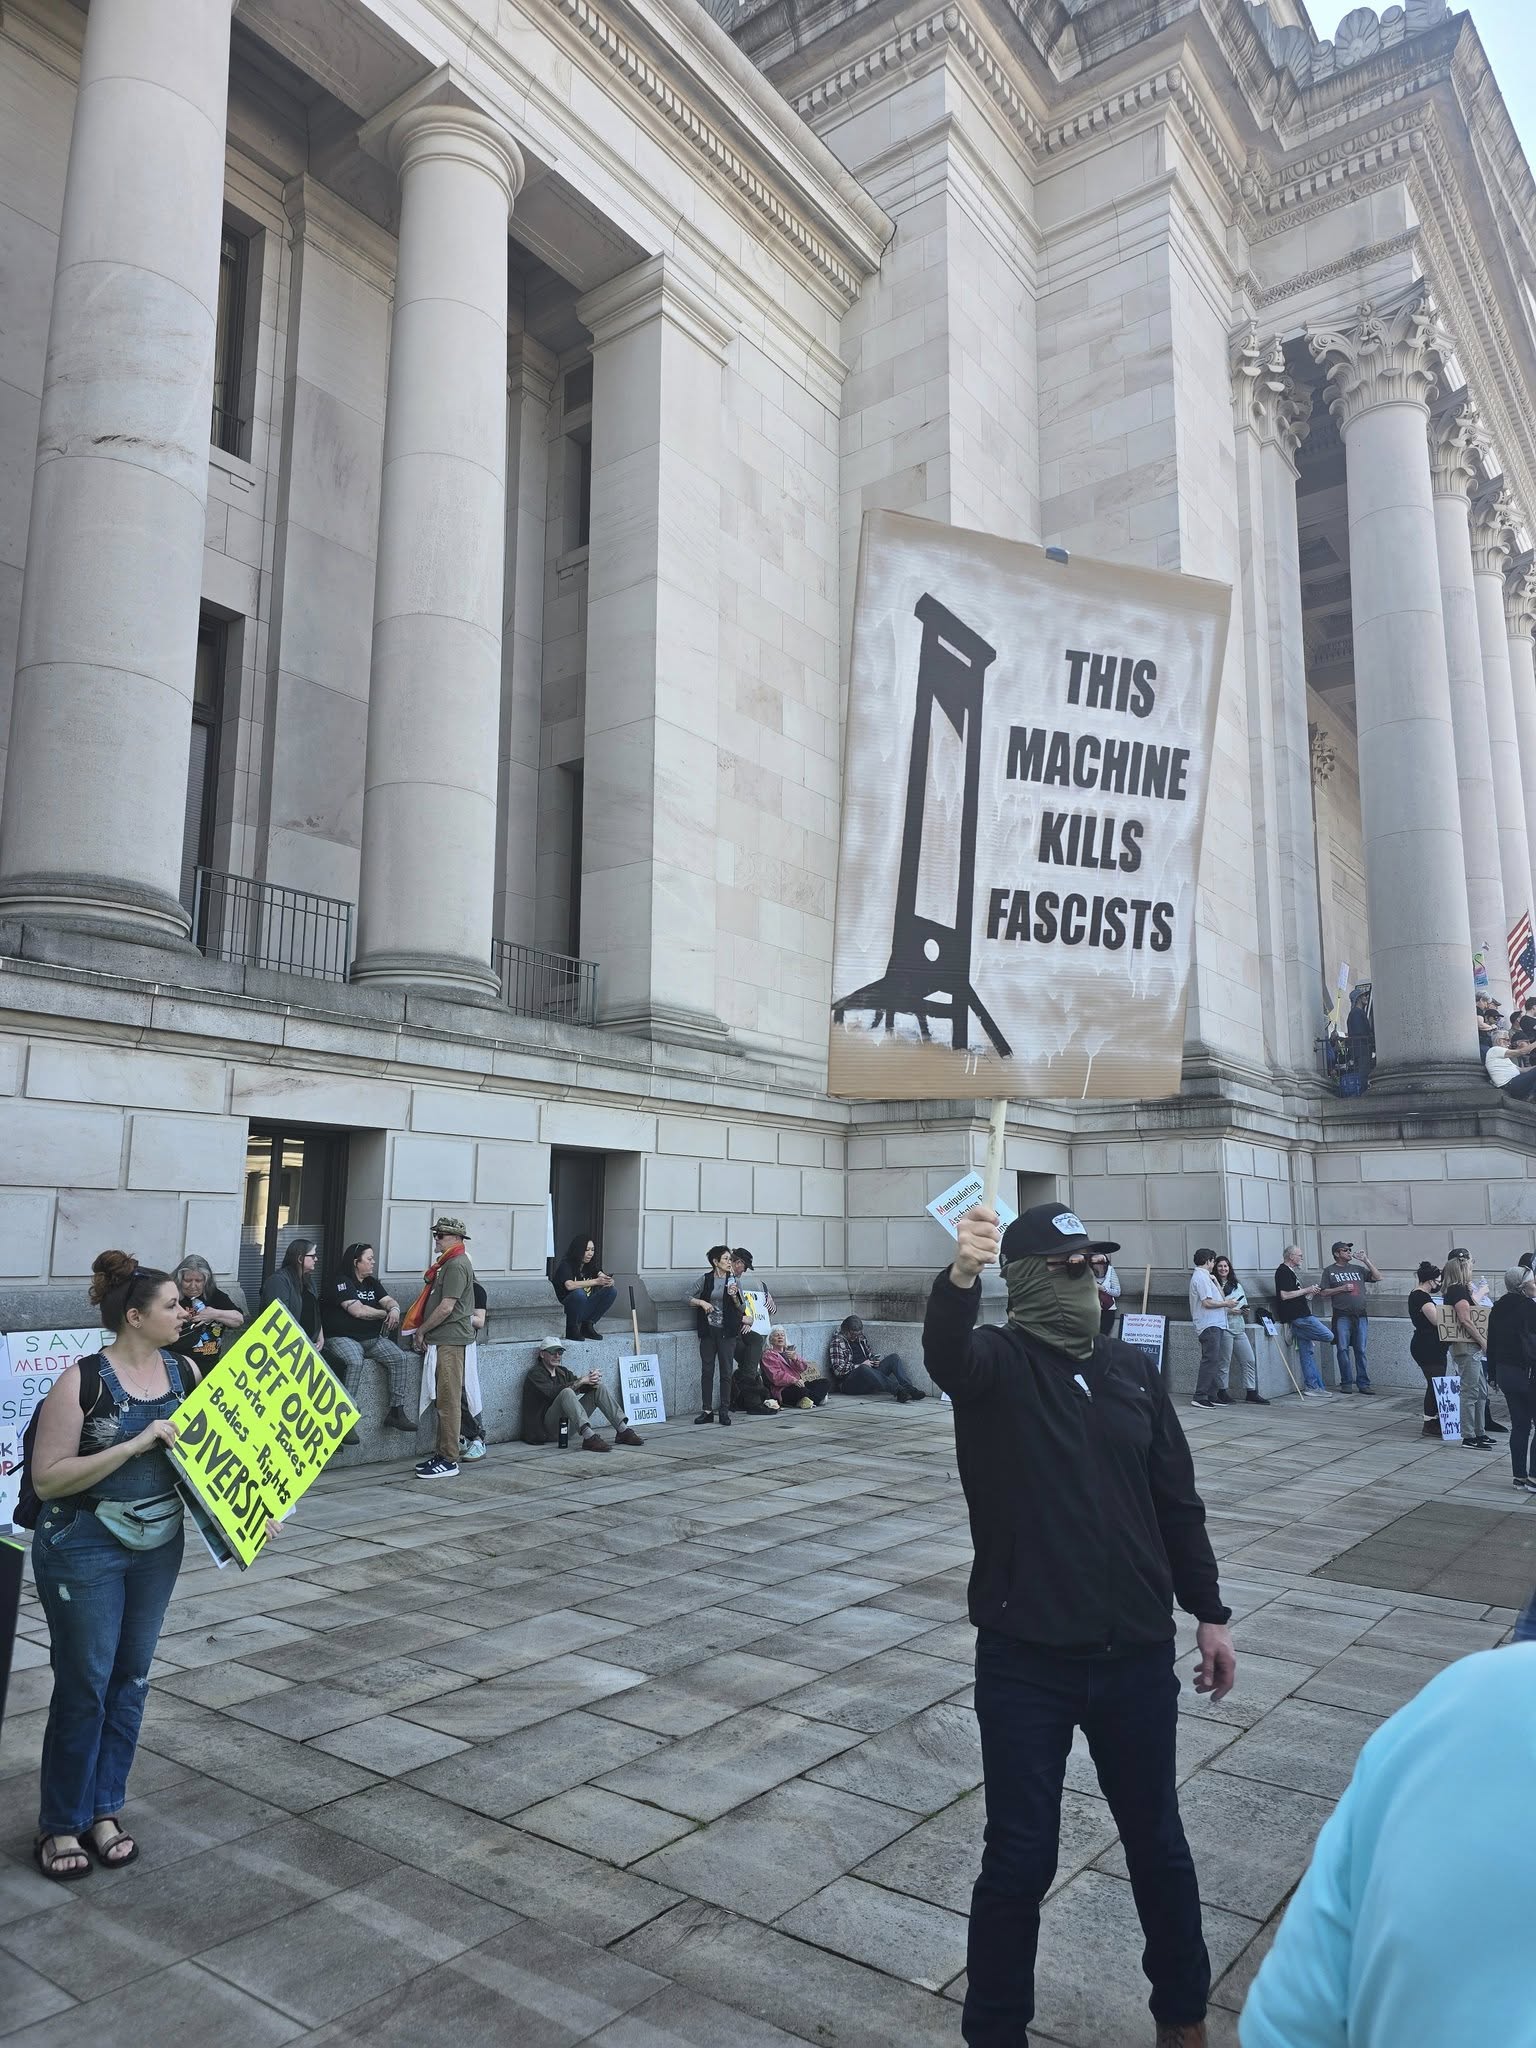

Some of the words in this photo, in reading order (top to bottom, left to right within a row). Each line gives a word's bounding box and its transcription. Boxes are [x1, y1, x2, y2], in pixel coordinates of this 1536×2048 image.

[1065, 649, 1157, 718] THIS
[1006, 726, 1191, 801] MACHINE
[1038, 811, 1144, 873] KILLS
[986, 888, 1174, 952] FASCISTS
[936, 1181, 982, 1215] Manipulating
[262, 1308, 352, 1440] HANDS
[628, 1377, 656, 1389] IMPEACH
[630, 1361, 651, 1373] TRUMP
[642, 1392, 658, 1403] ELON
[245, 1342, 290, 1396] OFF
[281, 1392, 329, 1469] OUR:
[634, 1408, 658, 1421] DEPORT
